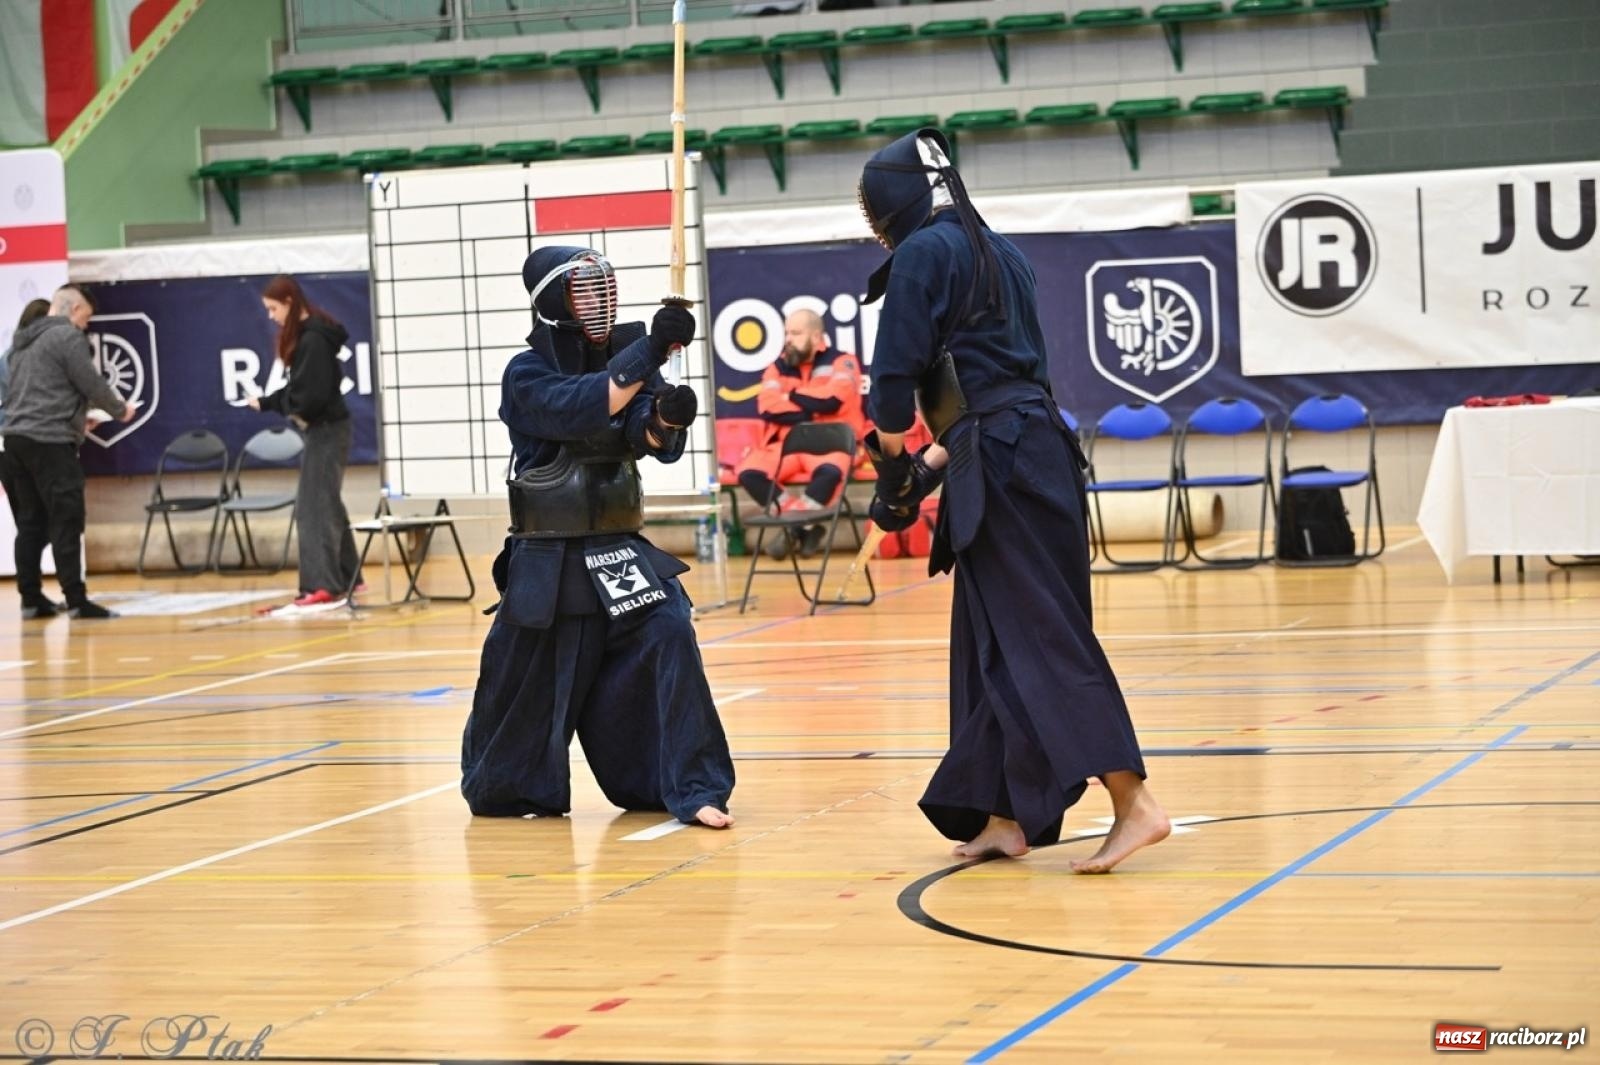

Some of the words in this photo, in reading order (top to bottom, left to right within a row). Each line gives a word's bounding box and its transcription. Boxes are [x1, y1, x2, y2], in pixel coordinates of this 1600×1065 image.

[379, 180, 391, 202] Y
[1482, 179, 1597, 255] JU
[1277, 216, 1359, 291] JR
[1482, 285, 1591, 311] ROZ
[584, 546, 638, 570] WARSZAWA
[609, 589, 667, 616] SIELICKI
